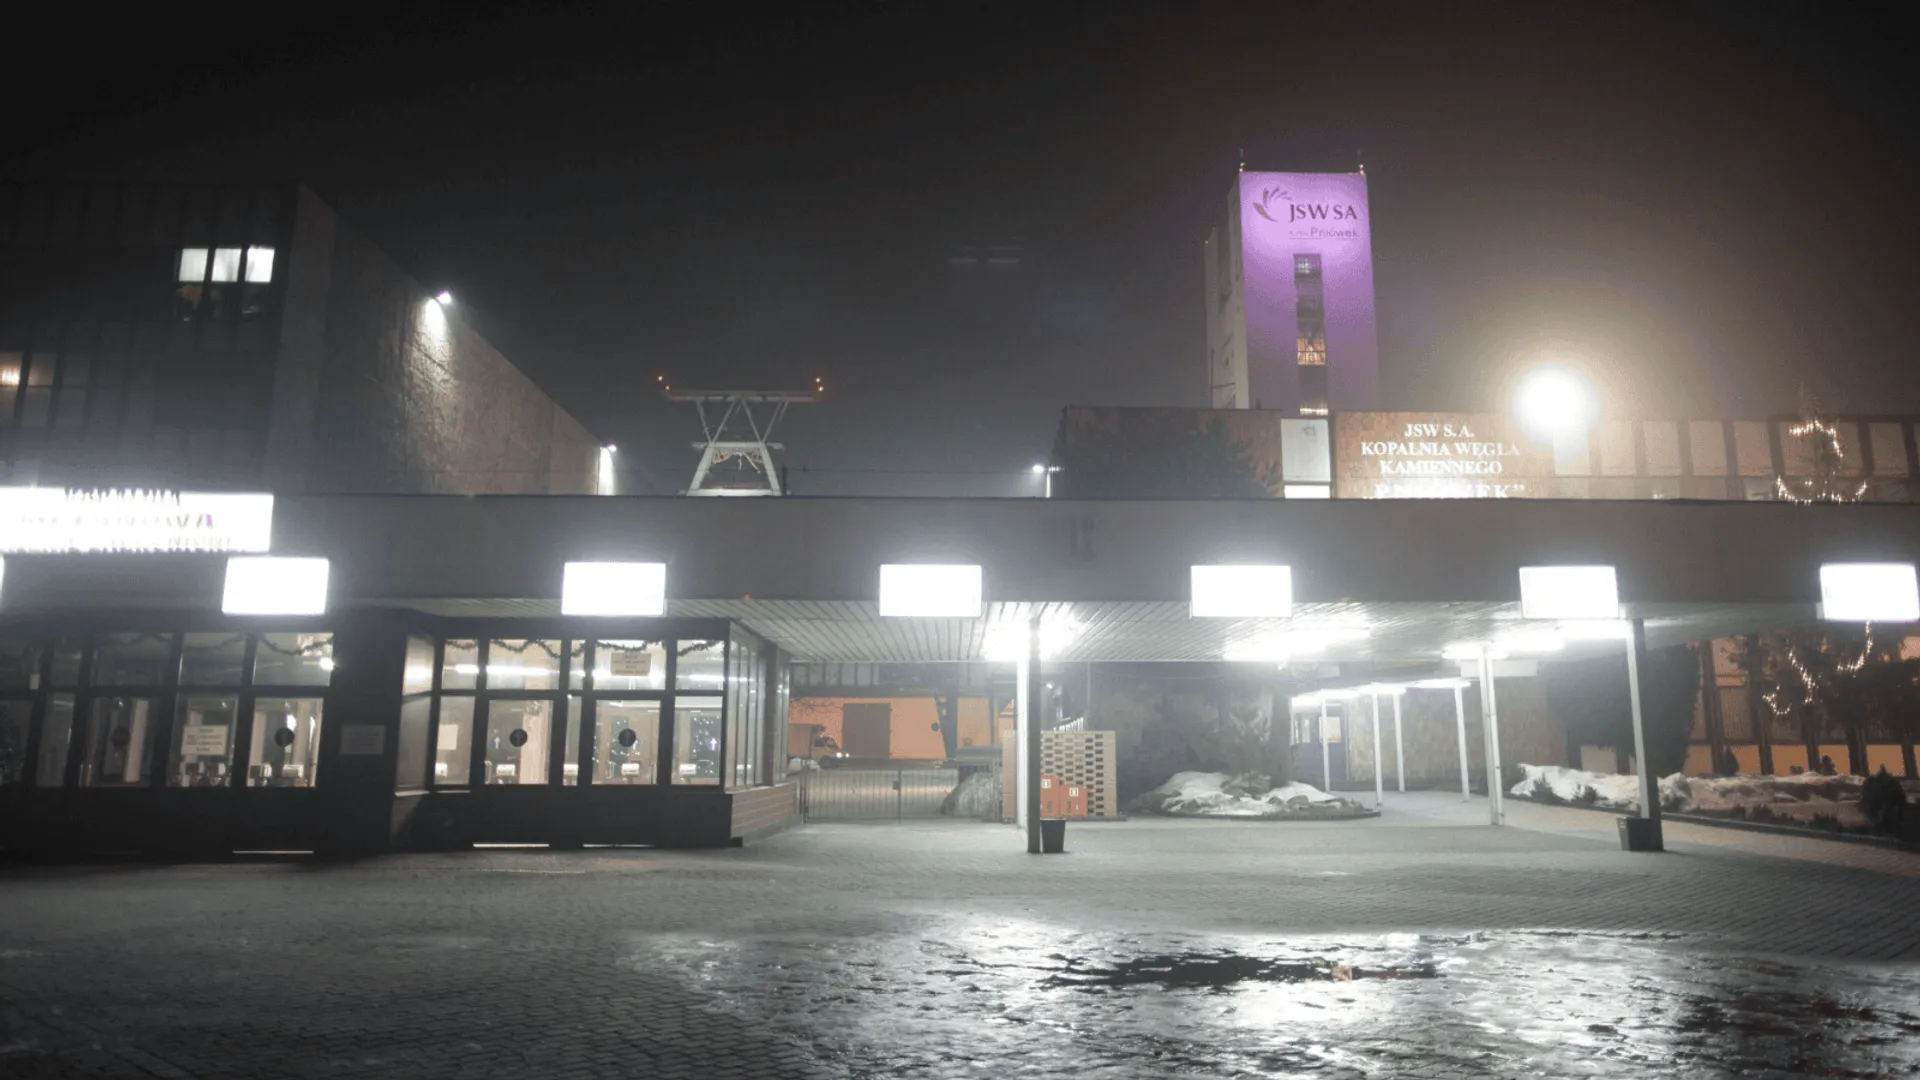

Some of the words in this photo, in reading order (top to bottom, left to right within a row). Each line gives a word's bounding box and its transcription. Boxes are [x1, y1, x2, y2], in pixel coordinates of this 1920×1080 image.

[1288, 204, 1329, 223] JSW
[1333, 204, 1358, 220] SA
[1405, 424, 1440, 437] JSW
[1361, 442, 1451, 456] KOPALNIA
[1454, 442, 1520, 458] WĘGLA
[1380, 459, 1503, 474] KAMIENNEGO
